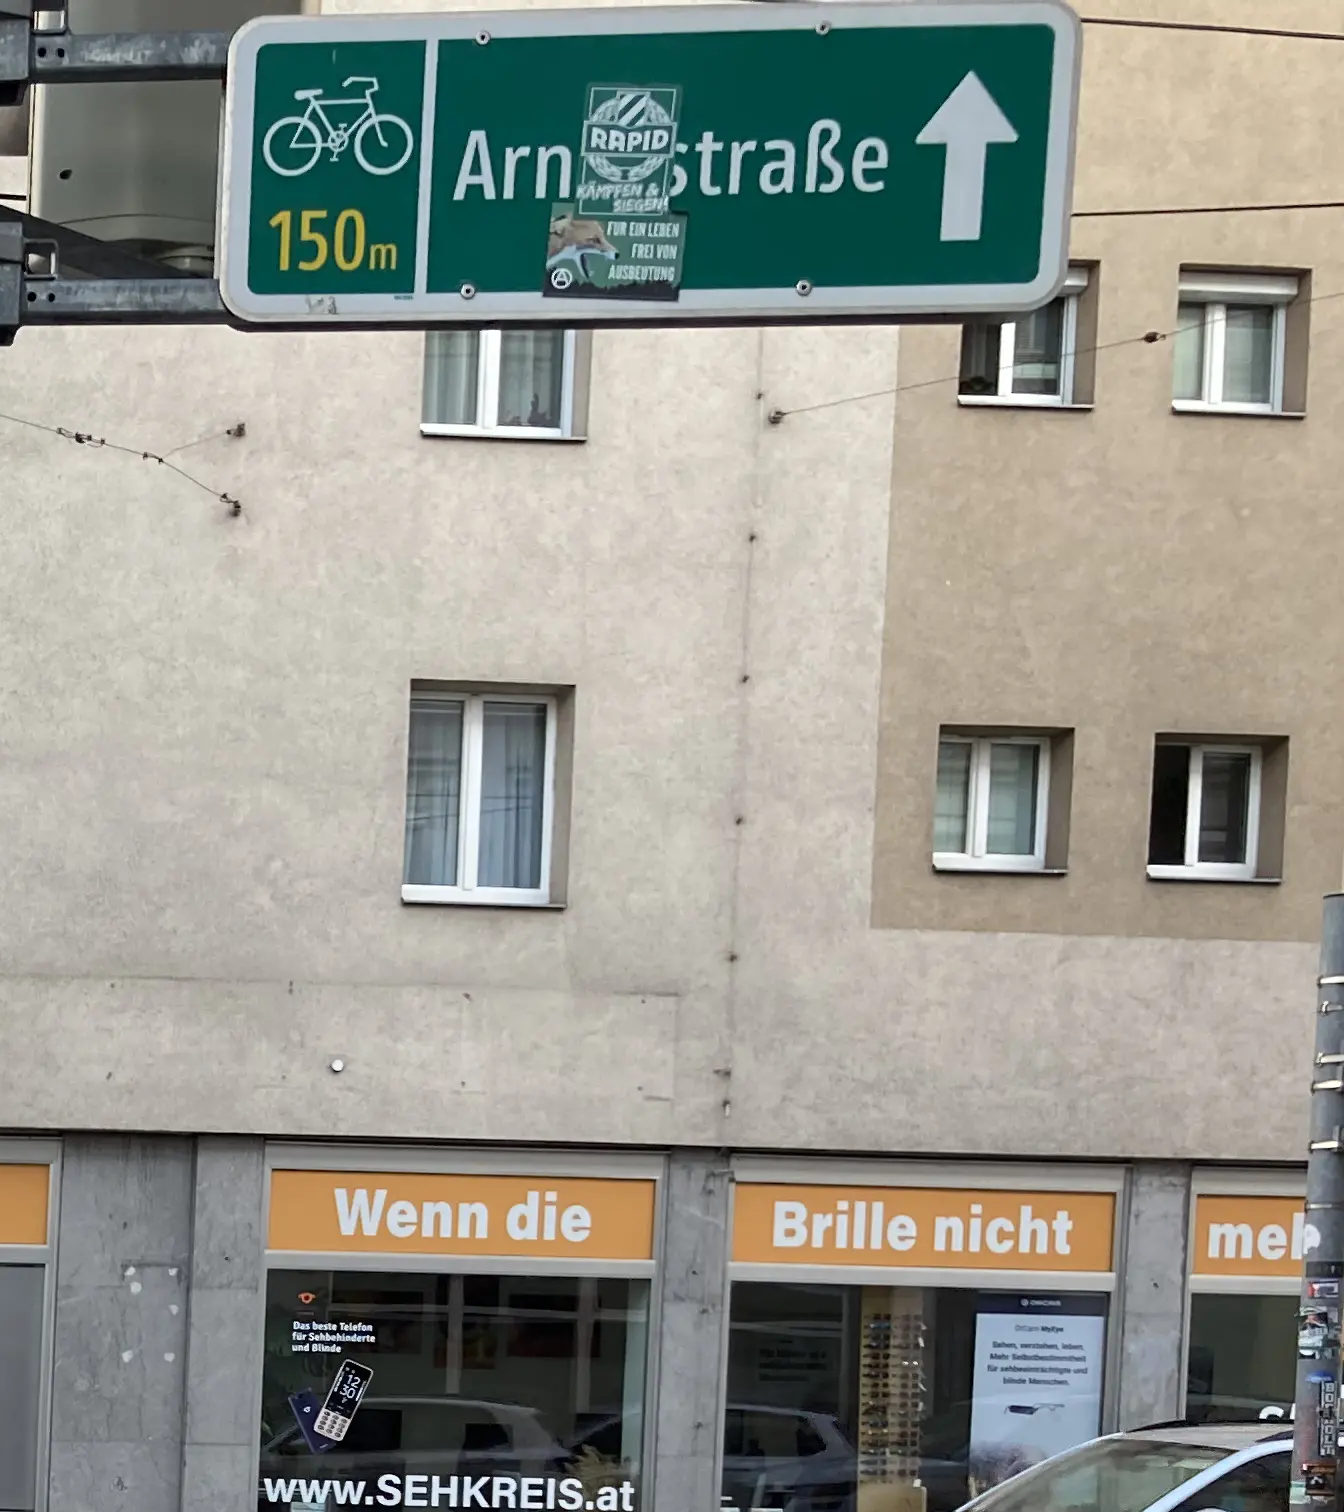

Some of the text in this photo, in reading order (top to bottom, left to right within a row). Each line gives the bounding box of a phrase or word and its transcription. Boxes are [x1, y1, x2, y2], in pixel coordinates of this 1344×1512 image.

[590, 126, 670, 152] RAPID
[453, 117, 890, 203] Arnstraße
[631, 243, 678, 260] FREI VON
[333, 1188, 593, 1242] Wenn die
[772, 1200, 1073, 1255] Brille nicht
[292, 1320, 374, 1332] Das beste Telefon
[292, 1332, 376, 1343] für Sehbehinderte
[291, 1343, 342, 1353] und Blinde
[347, 1374, 362, 1389] 12
[339, 1384, 356, 1399] 30
[262, 1473, 636, 1512] www.SEHKREIS.at
